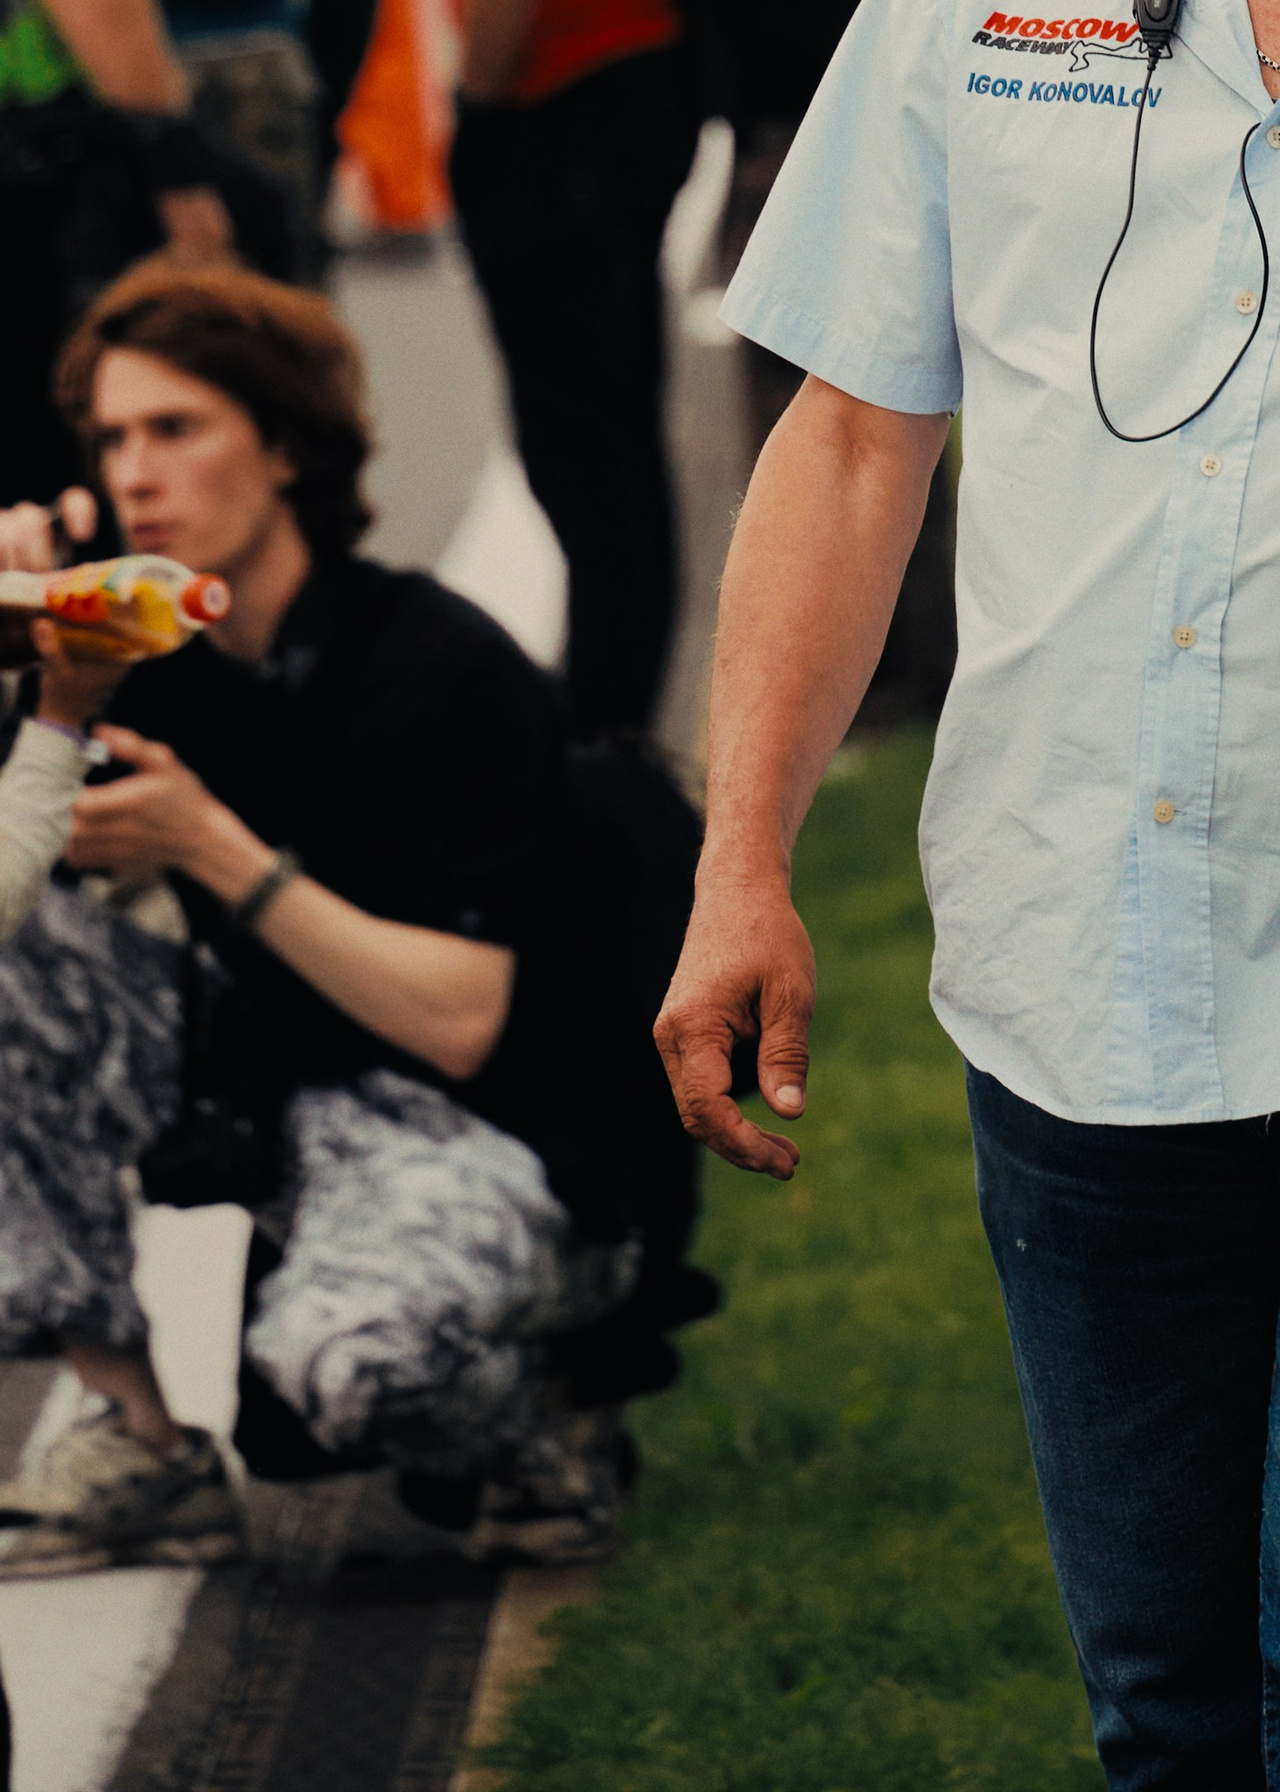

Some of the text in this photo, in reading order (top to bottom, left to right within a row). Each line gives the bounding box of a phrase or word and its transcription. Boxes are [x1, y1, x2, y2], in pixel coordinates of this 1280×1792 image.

[972, 30, 1074, 55] RACEWAY
[982, 11, 1140, 43] MOSCOW
[967, 72, 1162, 108] IGOR KONOVALOV
